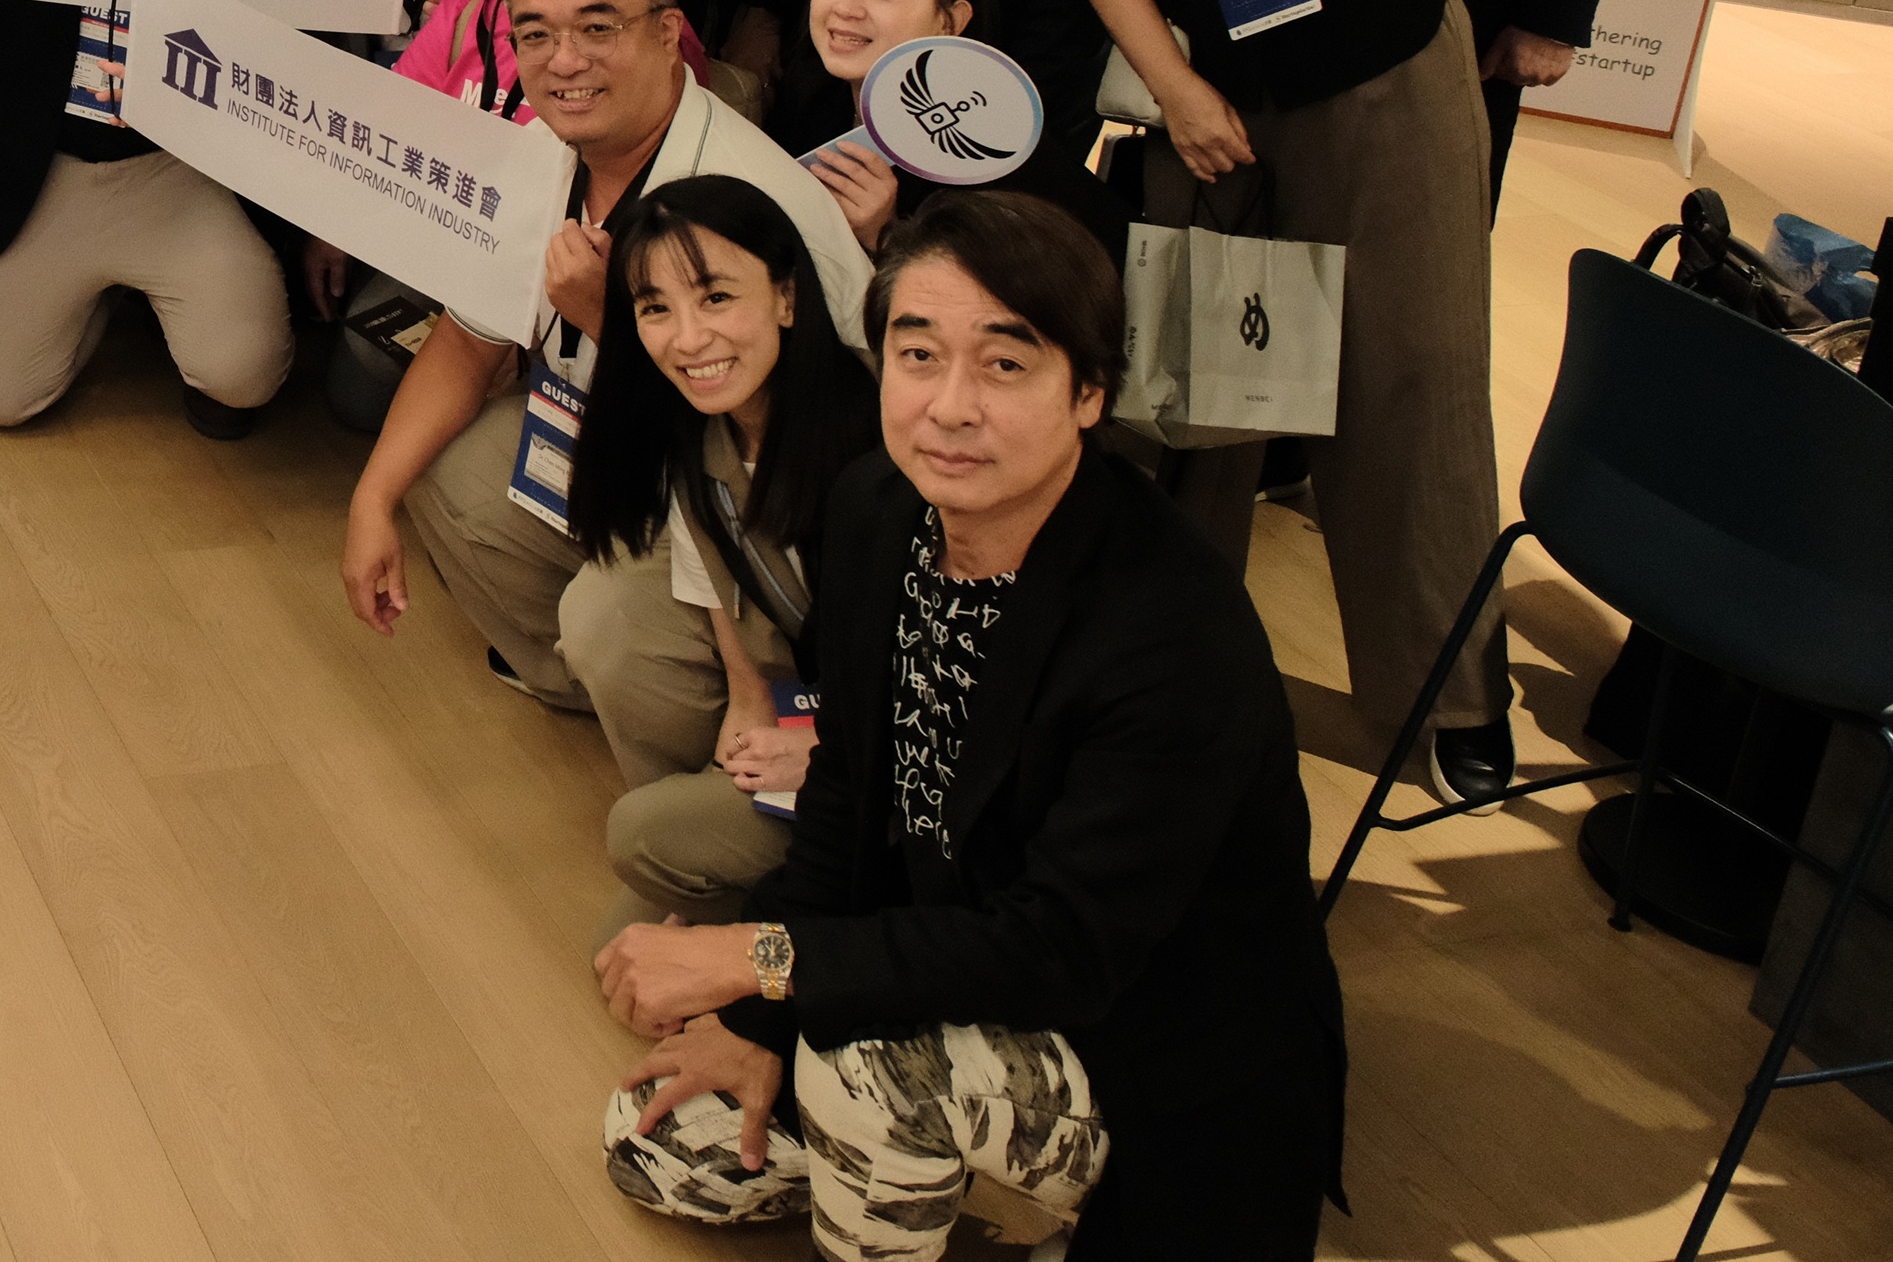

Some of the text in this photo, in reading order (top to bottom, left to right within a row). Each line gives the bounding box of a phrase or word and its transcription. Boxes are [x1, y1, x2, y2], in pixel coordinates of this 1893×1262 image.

[227, 99, 501, 256] INSTITUTE FOR INFORMATION INDUSTRY
[231, 61, 502, 223] 財團法人資訊工業策進會
[541, 380, 587, 417] GUEST
